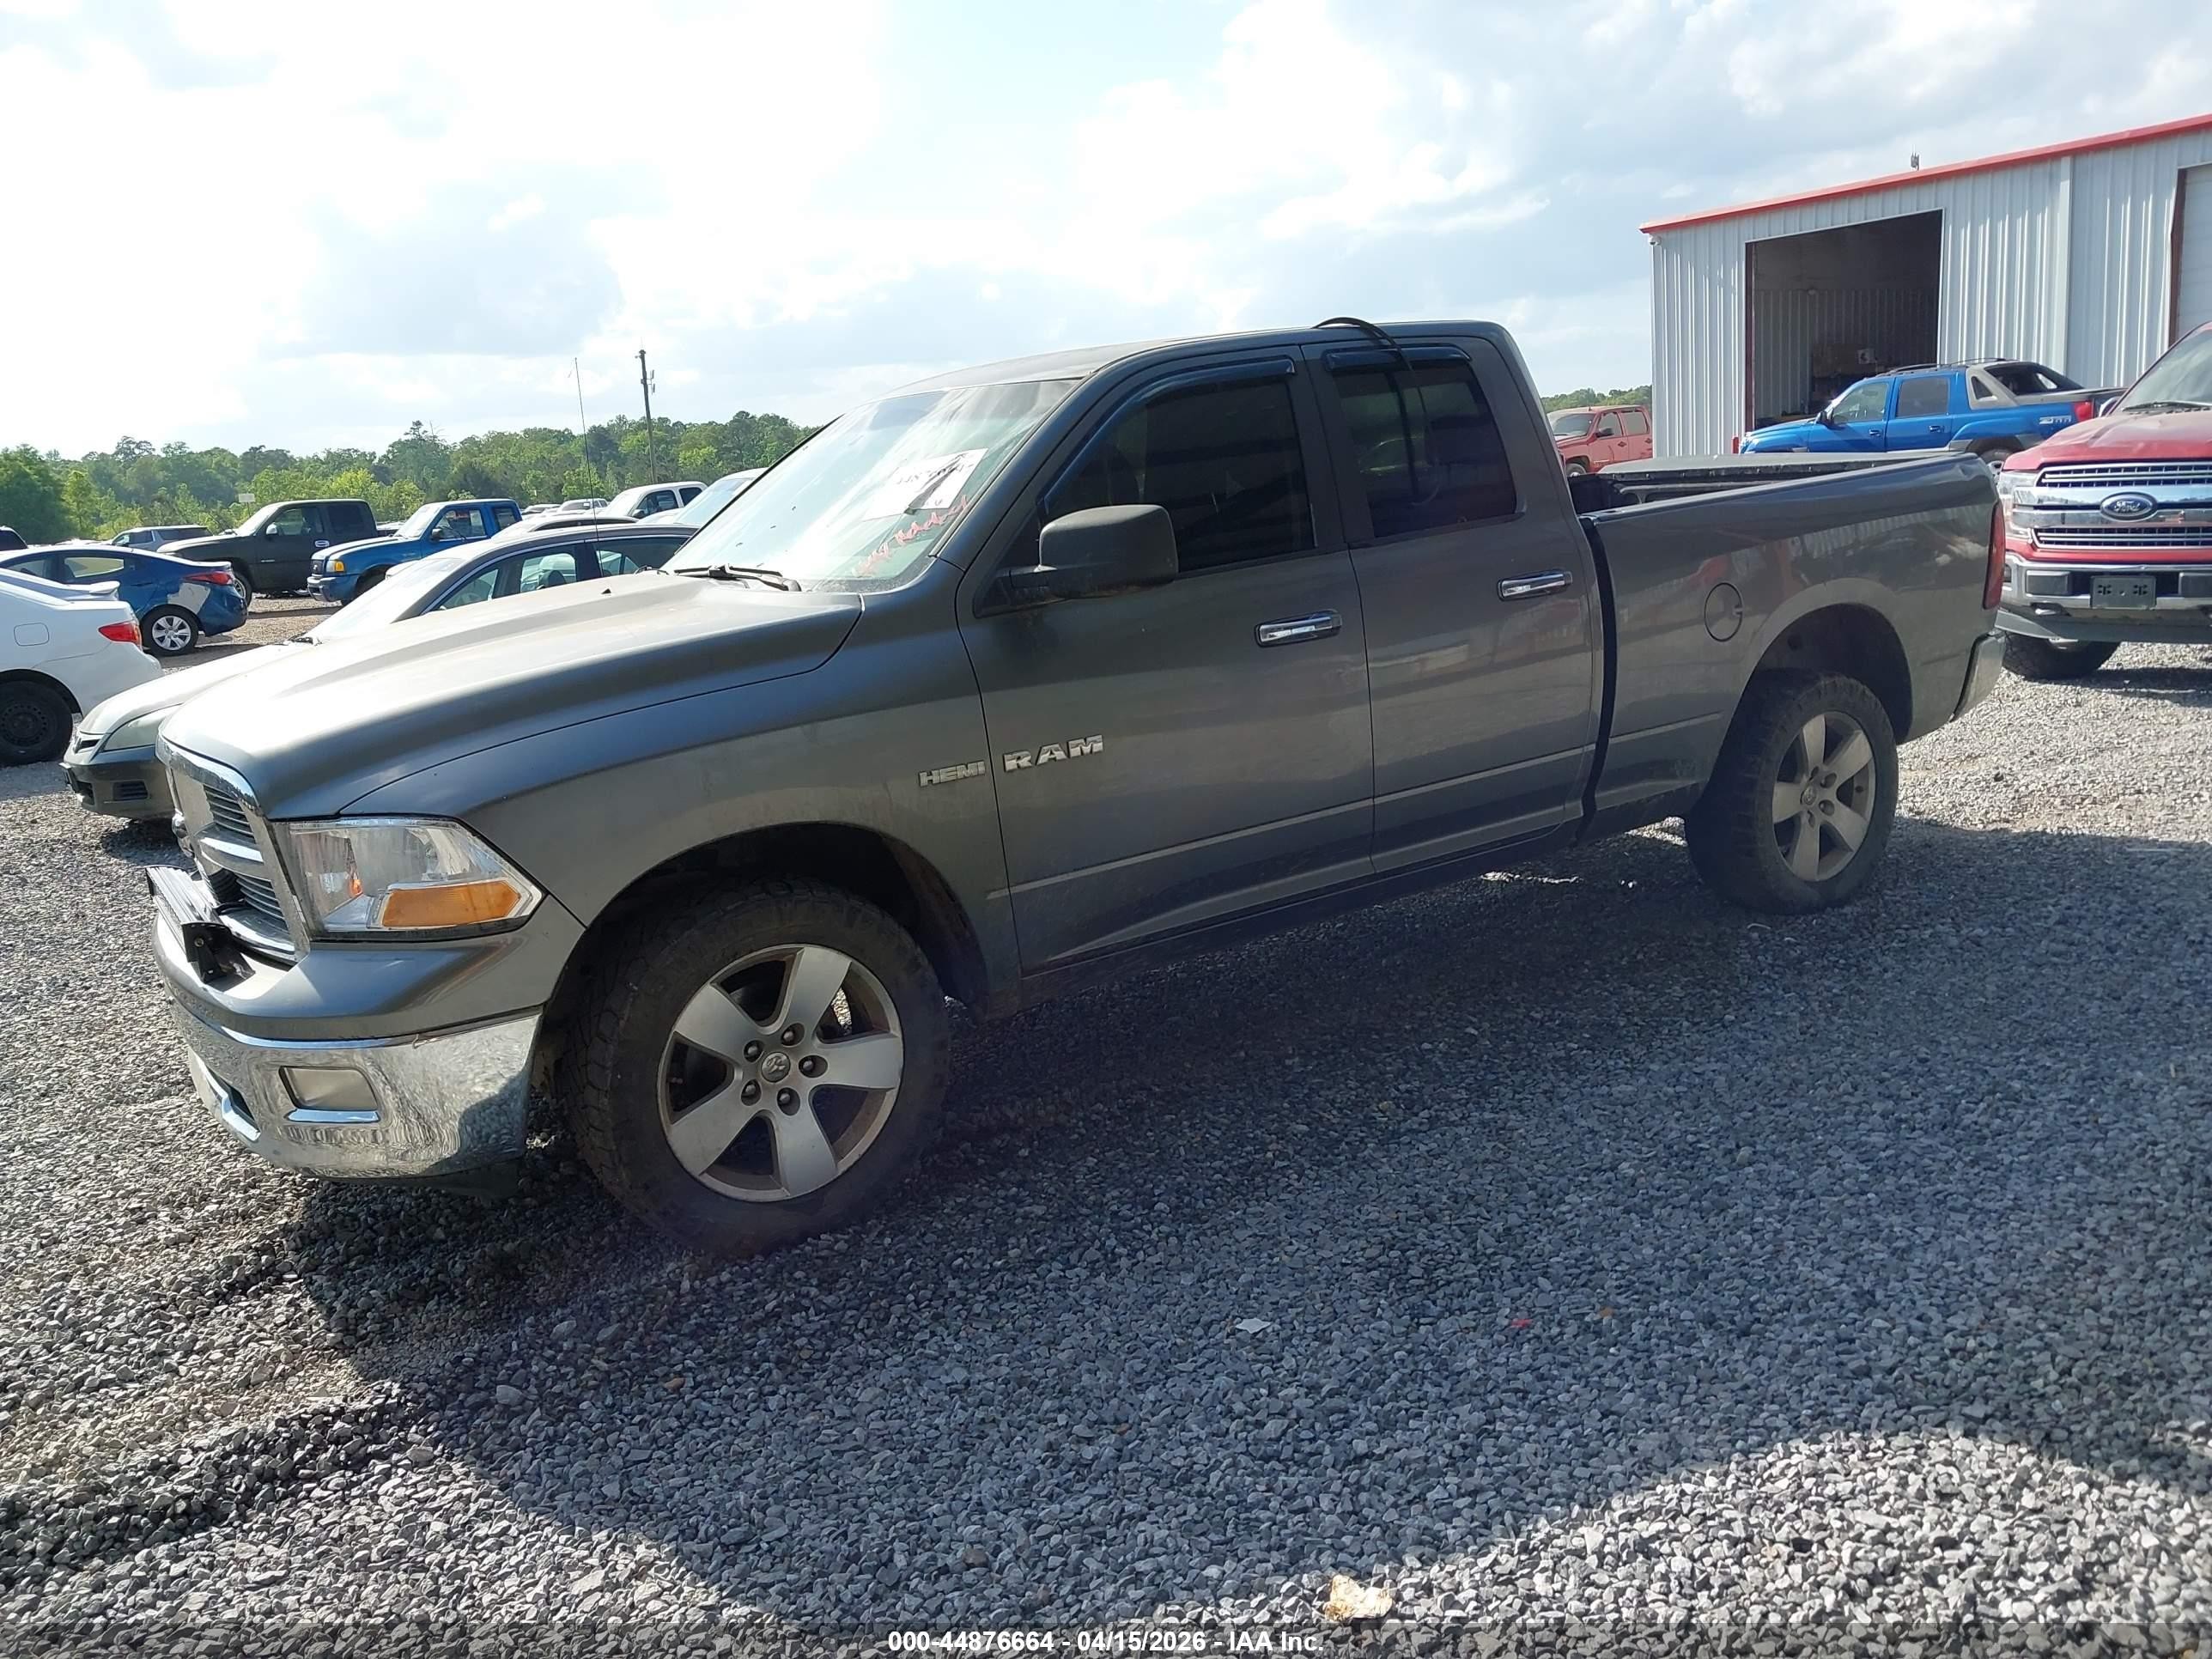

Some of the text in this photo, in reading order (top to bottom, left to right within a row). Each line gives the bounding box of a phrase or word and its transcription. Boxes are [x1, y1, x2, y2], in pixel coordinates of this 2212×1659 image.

[2113, 500, 2142, 514] Ford
[1003, 734, 1104, 772] RAM
[919, 760, 986, 787] HEMI
